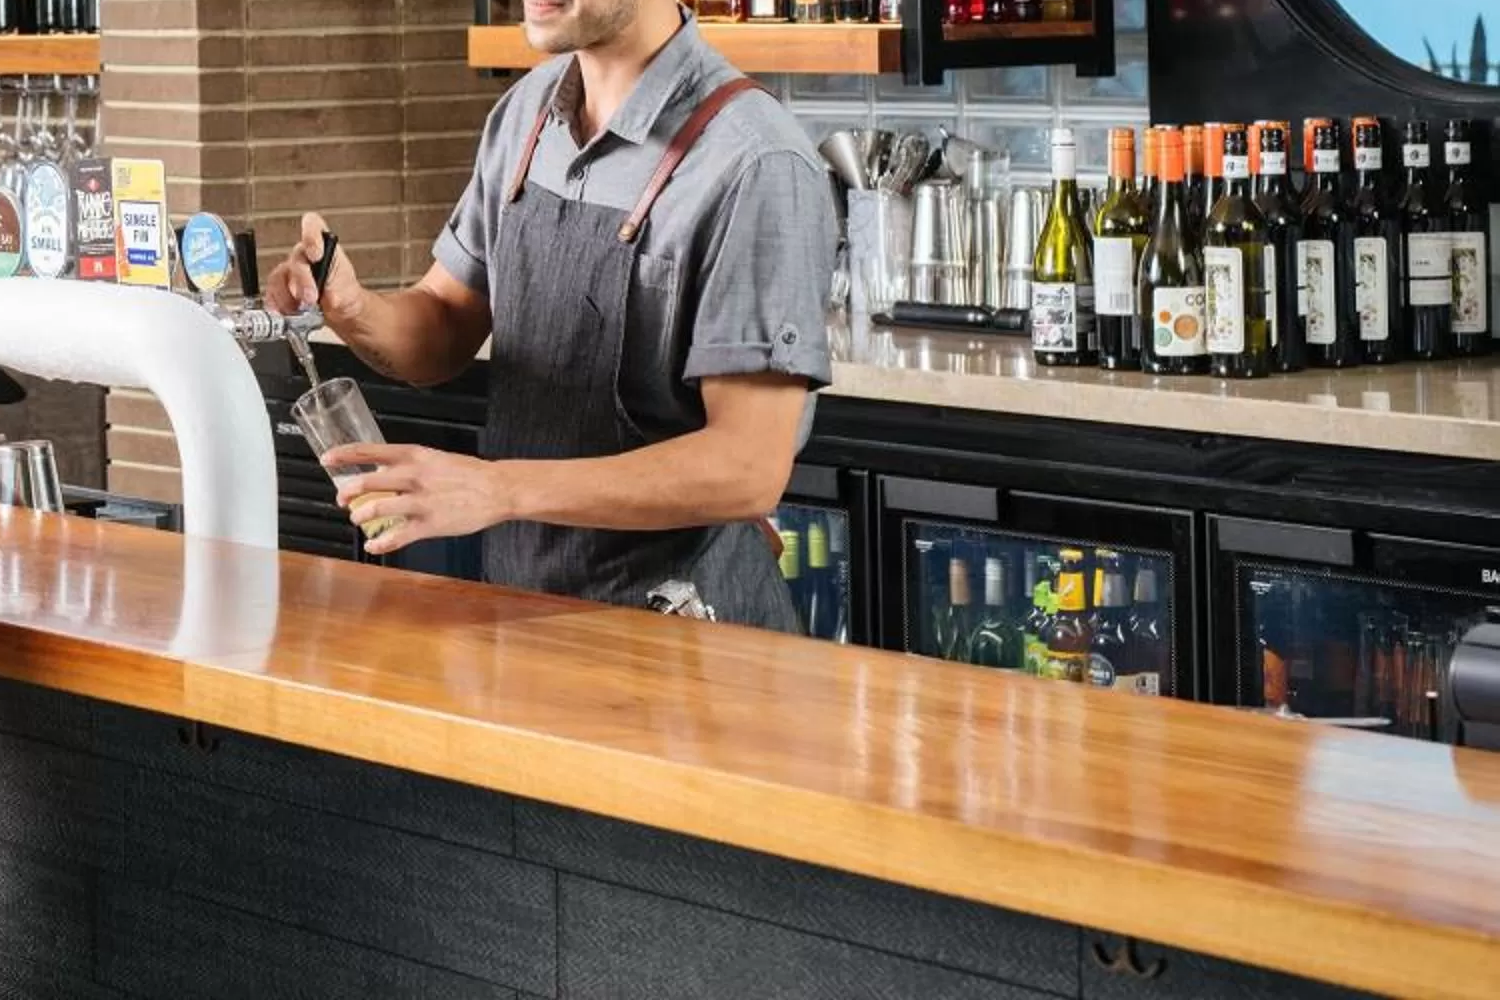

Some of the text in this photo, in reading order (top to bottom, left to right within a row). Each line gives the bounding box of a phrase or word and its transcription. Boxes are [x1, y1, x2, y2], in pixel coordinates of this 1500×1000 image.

[124, 213, 157, 227] SINGLE
[133, 229, 149, 243] FIN
[31, 236, 63, 253] SMALL
[1185, 293, 1206, 306] CO
[1481, 569, 1500, 584] BA
